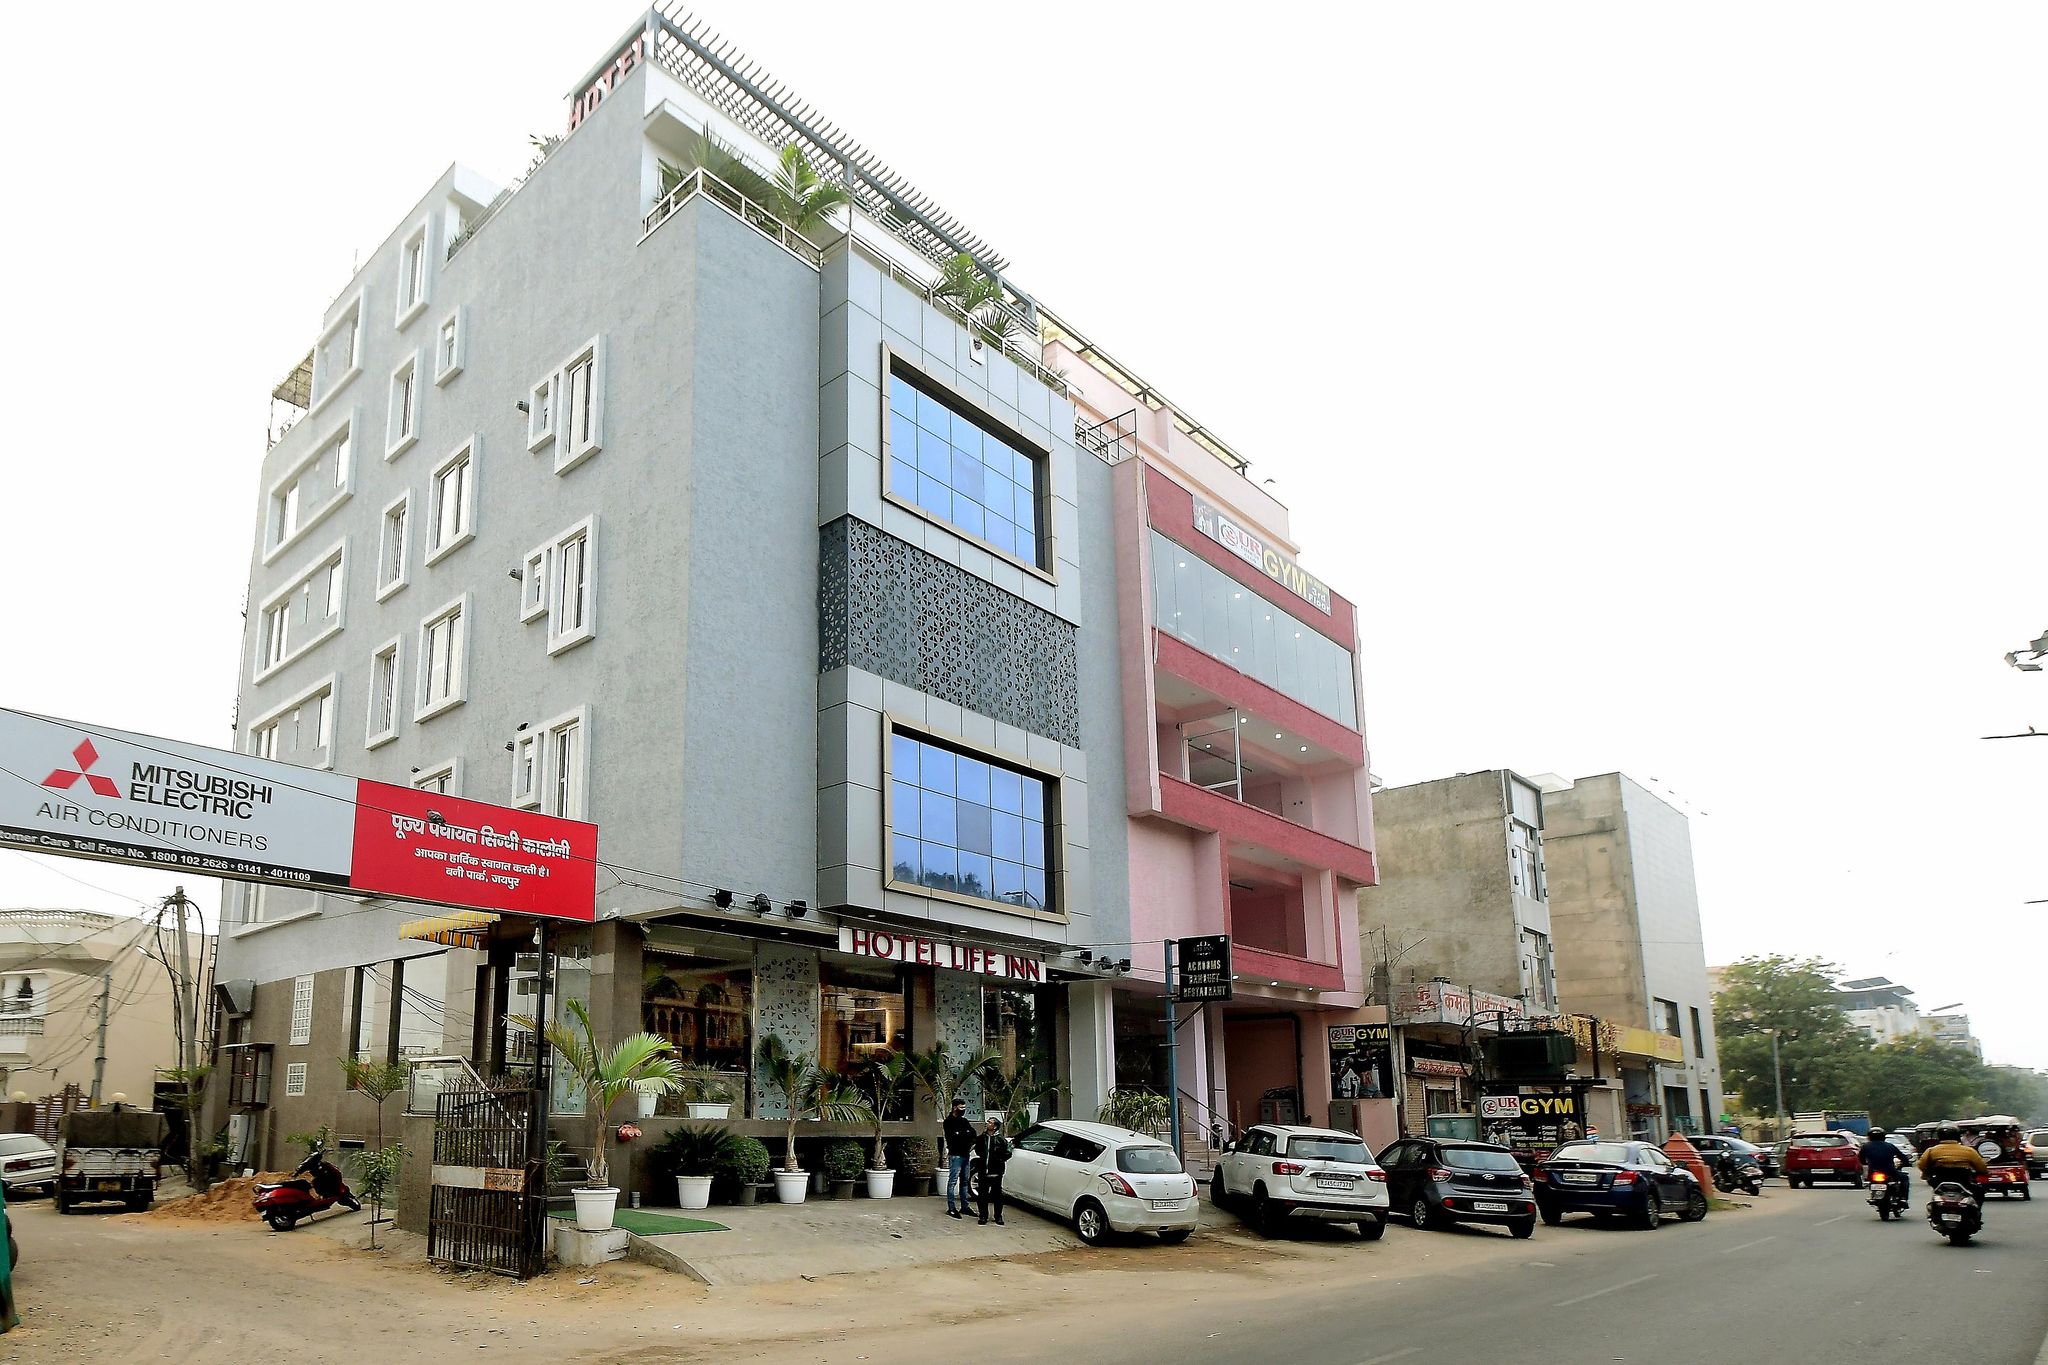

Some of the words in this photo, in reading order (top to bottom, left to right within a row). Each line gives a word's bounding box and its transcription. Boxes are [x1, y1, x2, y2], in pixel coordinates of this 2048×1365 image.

[1238, 529, 1261, 557] UR
[1263, 549, 1307, 598] GYM
[1311, 587, 1326, 603] 3rd
[132, 762, 273, 804] MITSUBISHI
[130, 783, 254, 819] ELECTRIC
[36, 802, 80, 822] AIR
[89, 809, 268, 851] CONDITIONERS
[428, 821, 479, 844] पचायत
[39, 835, 71, 848] Care
[72, 840, 96, 852] Toll
[98, 843, 126, 855] Free
[127, 847, 148, 860] No.
[151, 851, 178, 863] 1800
[181, 854, 200, 866] 102
[202, 857, 229, 870] 2626
[271, 868, 311, 882] 4011109
[414, 847, 448, 861] आपका
[449, 852, 480, 866] हार्दिक
[480, 858, 511, 871] स्वागत
[512, 863, 537, 875] करती
[445, 866, 464, 878] बनी
[491, 874, 520, 889] जयपुर
[852, 928, 944, 967] HOTEL
[951, 944, 997, 975] LIFE
[1006, 954, 1041, 982] INN
[1341, 1028, 1354, 1036] UR
[1356, 1027, 1388, 1039] GYM
[1498, 1097, 1519, 1107] UR
[1521, 1098, 1574, 1115] GYM
